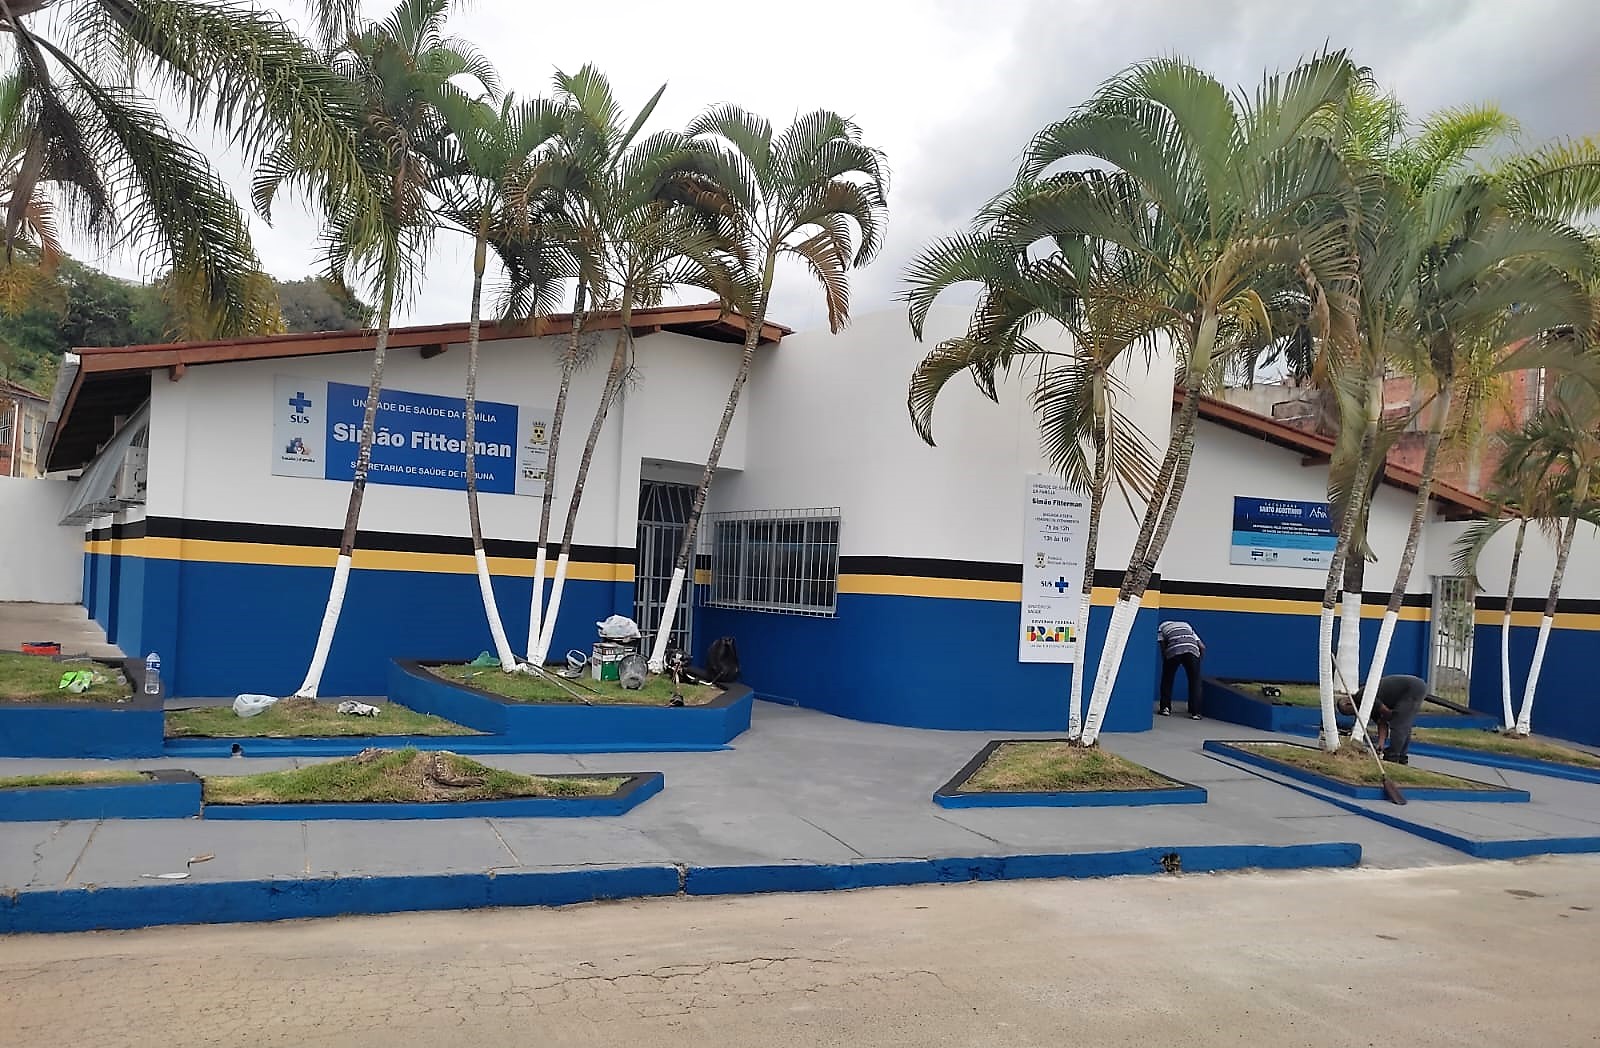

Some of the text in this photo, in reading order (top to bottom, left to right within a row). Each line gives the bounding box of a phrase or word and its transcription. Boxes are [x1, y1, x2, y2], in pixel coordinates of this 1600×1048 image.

[352, 399, 497, 423] UNADE DE SAÚDE DA FMÍLIA
[290, 414, 310, 424] SUS
[350, 461, 495, 481] SRETARIA DE SAÚDE DE ITUNA
[1032, 497, 1082, 507] Simão Fitterman
[1040, 580, 1053, 588] SUS
[1026, 625, 1077, 643] BRASIL
